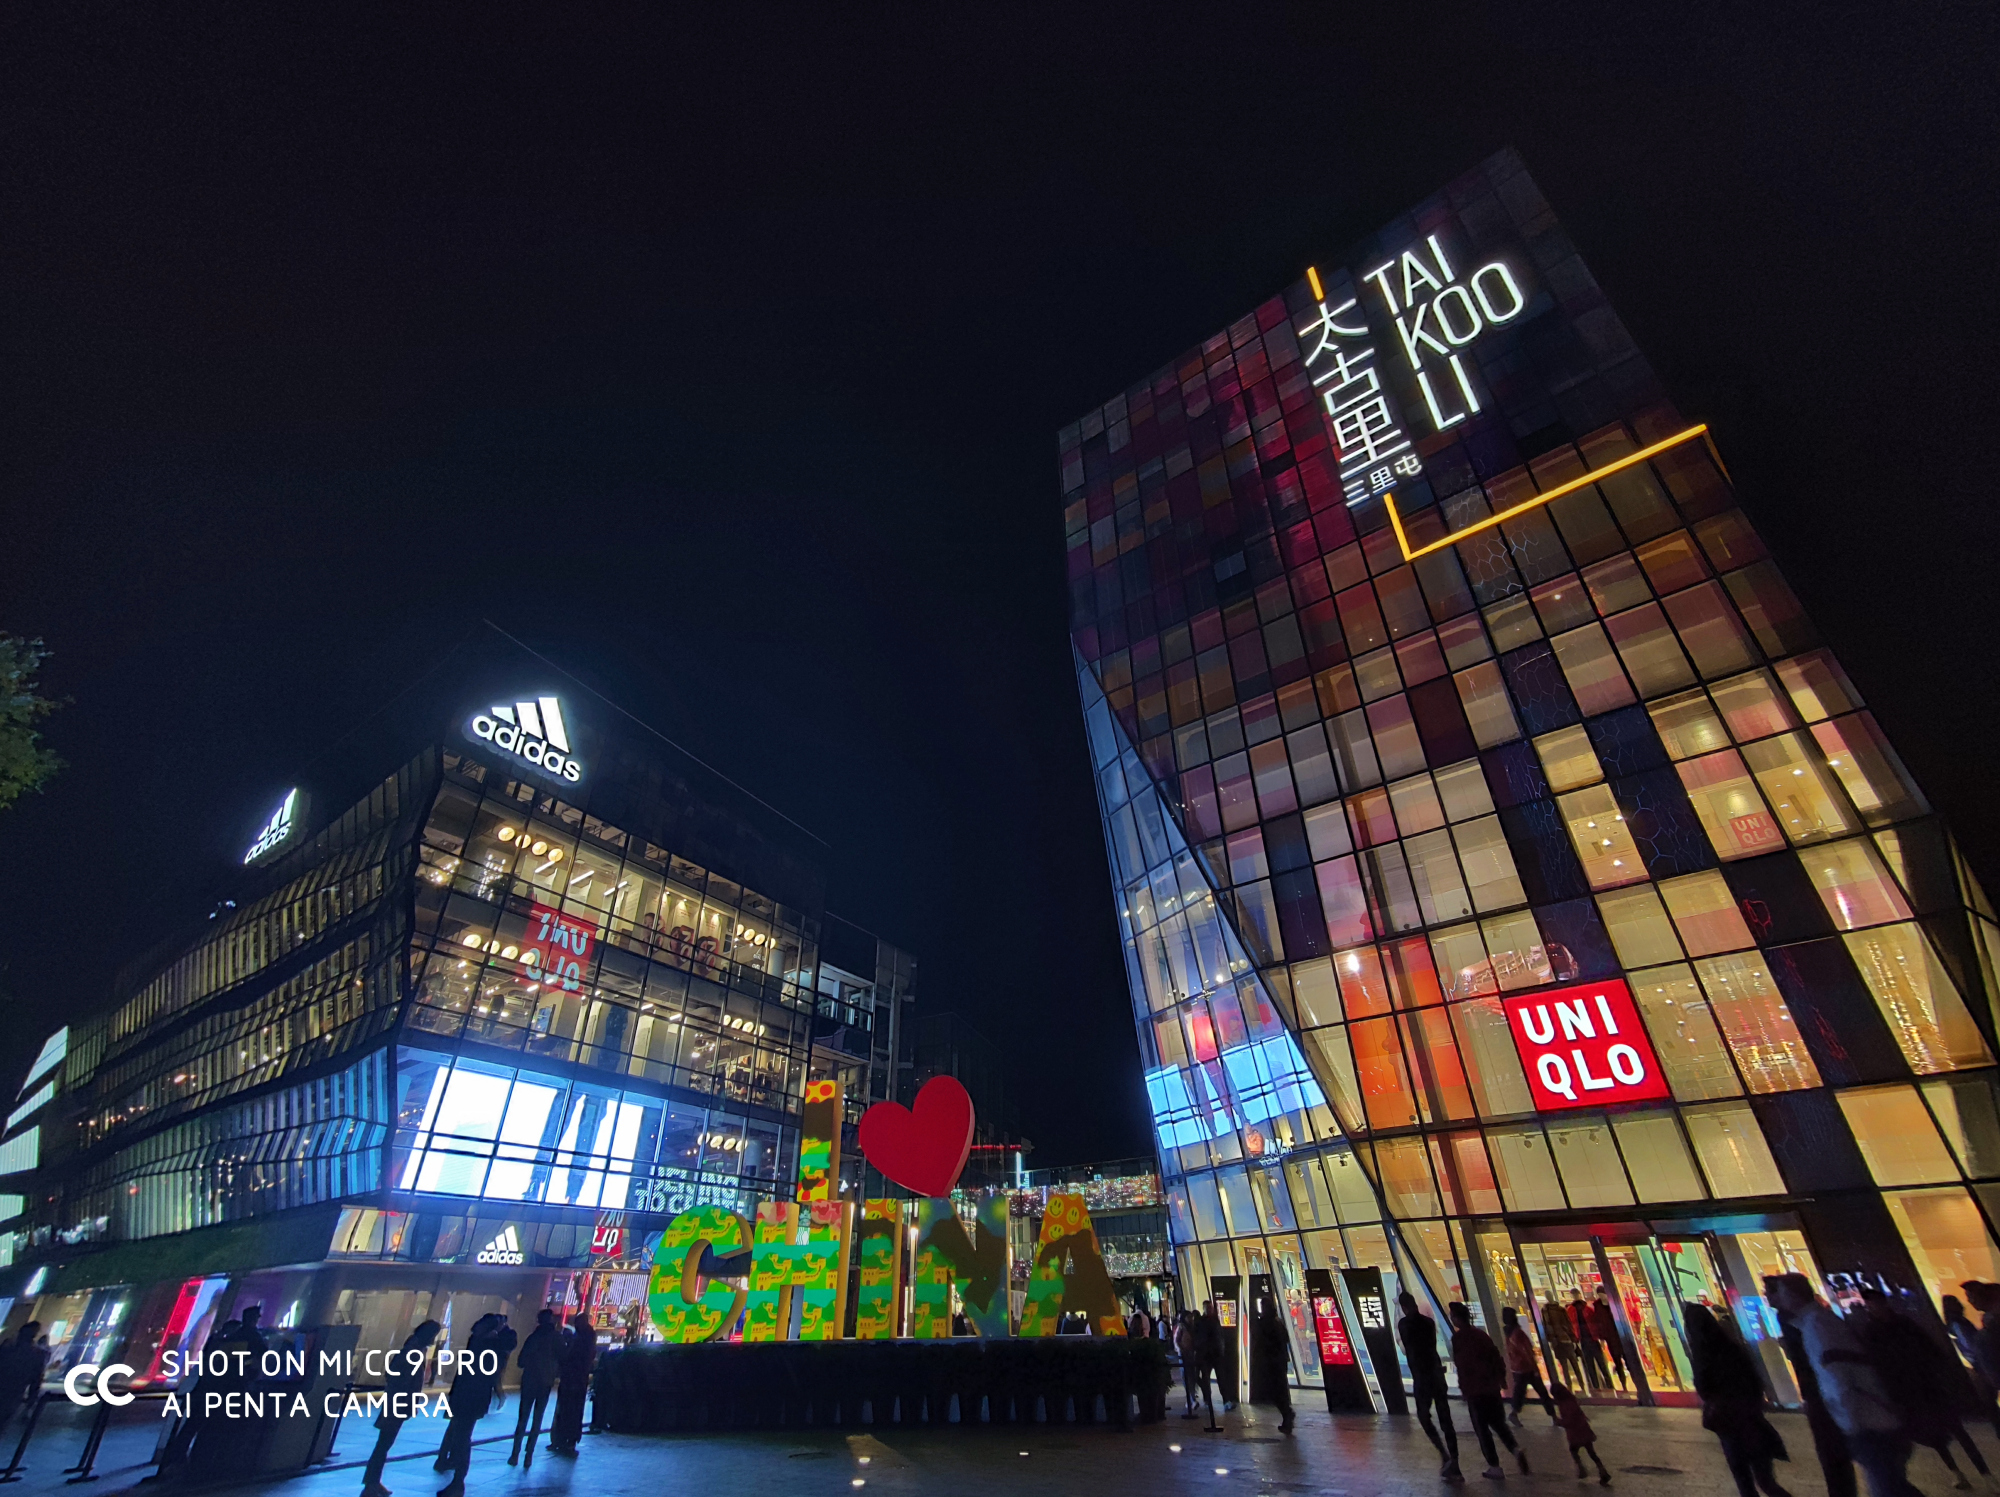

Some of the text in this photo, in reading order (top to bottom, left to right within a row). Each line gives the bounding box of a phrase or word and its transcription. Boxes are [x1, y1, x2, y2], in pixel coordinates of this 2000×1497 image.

[1363, 235, 1455, 315] TAI
[1396, 262, 1523, 370] KOO
[1299, 298, 1411, 480] 太古里
[1417, 354, 1480, 431] LI
[1343, 453, 1422, 507] 三里屯
[472, 715, 581, 782] adidas
[244, 821, 292, 865] adidas
[1734, 816, 1767, 832] UNI
[1741, 827, 1776, 845] QLO
[1518, 995, 1619, 1045] UNI
[1537, 1043, 1645, 1101] QLO
[797, 1079, 843, 1202] I
[635, 1188, 667, 1213] TO
[477, 1249, 524, 1265] adidas
[648, 1194, 1128, 1344] CHINA
